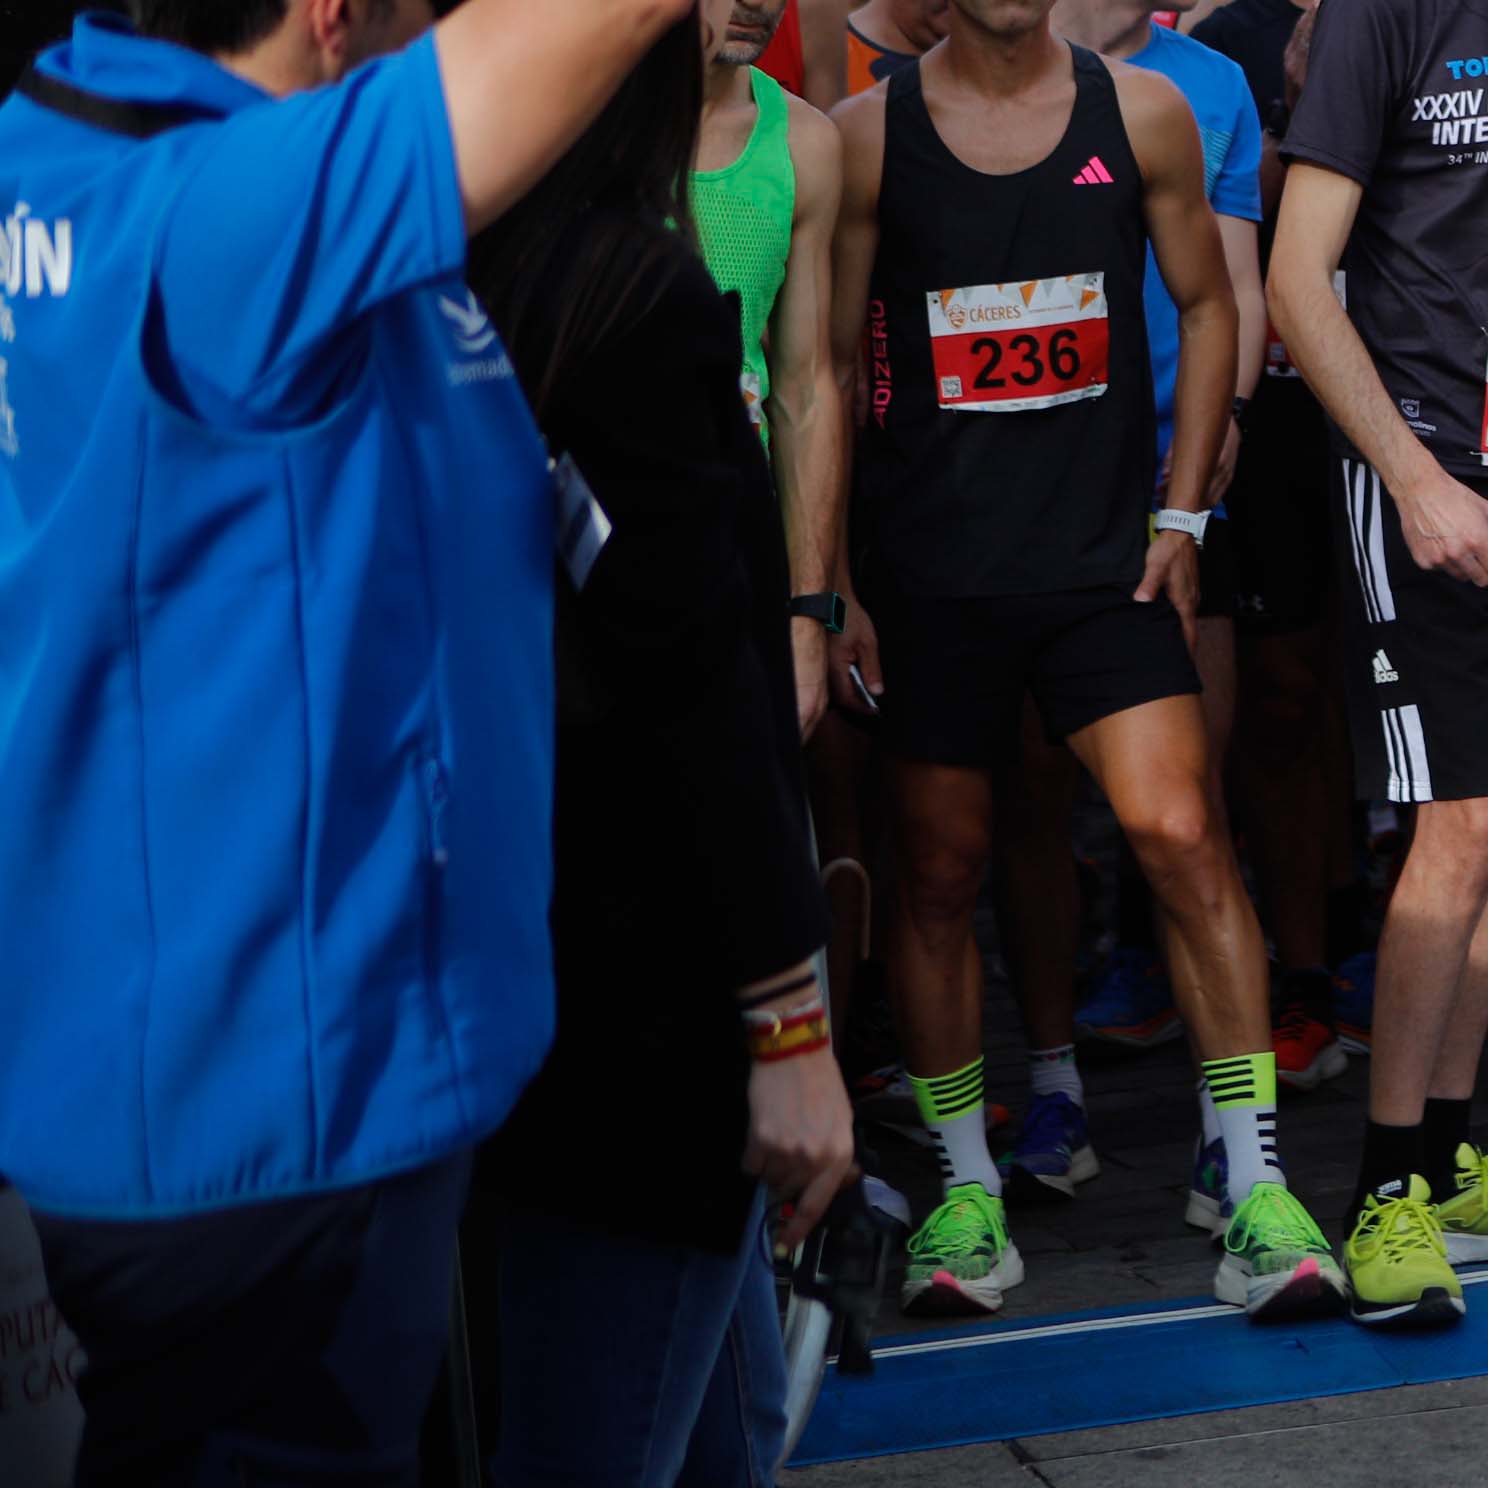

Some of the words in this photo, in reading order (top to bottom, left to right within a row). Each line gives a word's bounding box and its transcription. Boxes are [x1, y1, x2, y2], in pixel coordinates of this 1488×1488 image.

[1412, 88, 1484, 122] XXXIV
[969, 304, 1021, 324] CÁCERES
[969, 328, 1081, 390] 236
